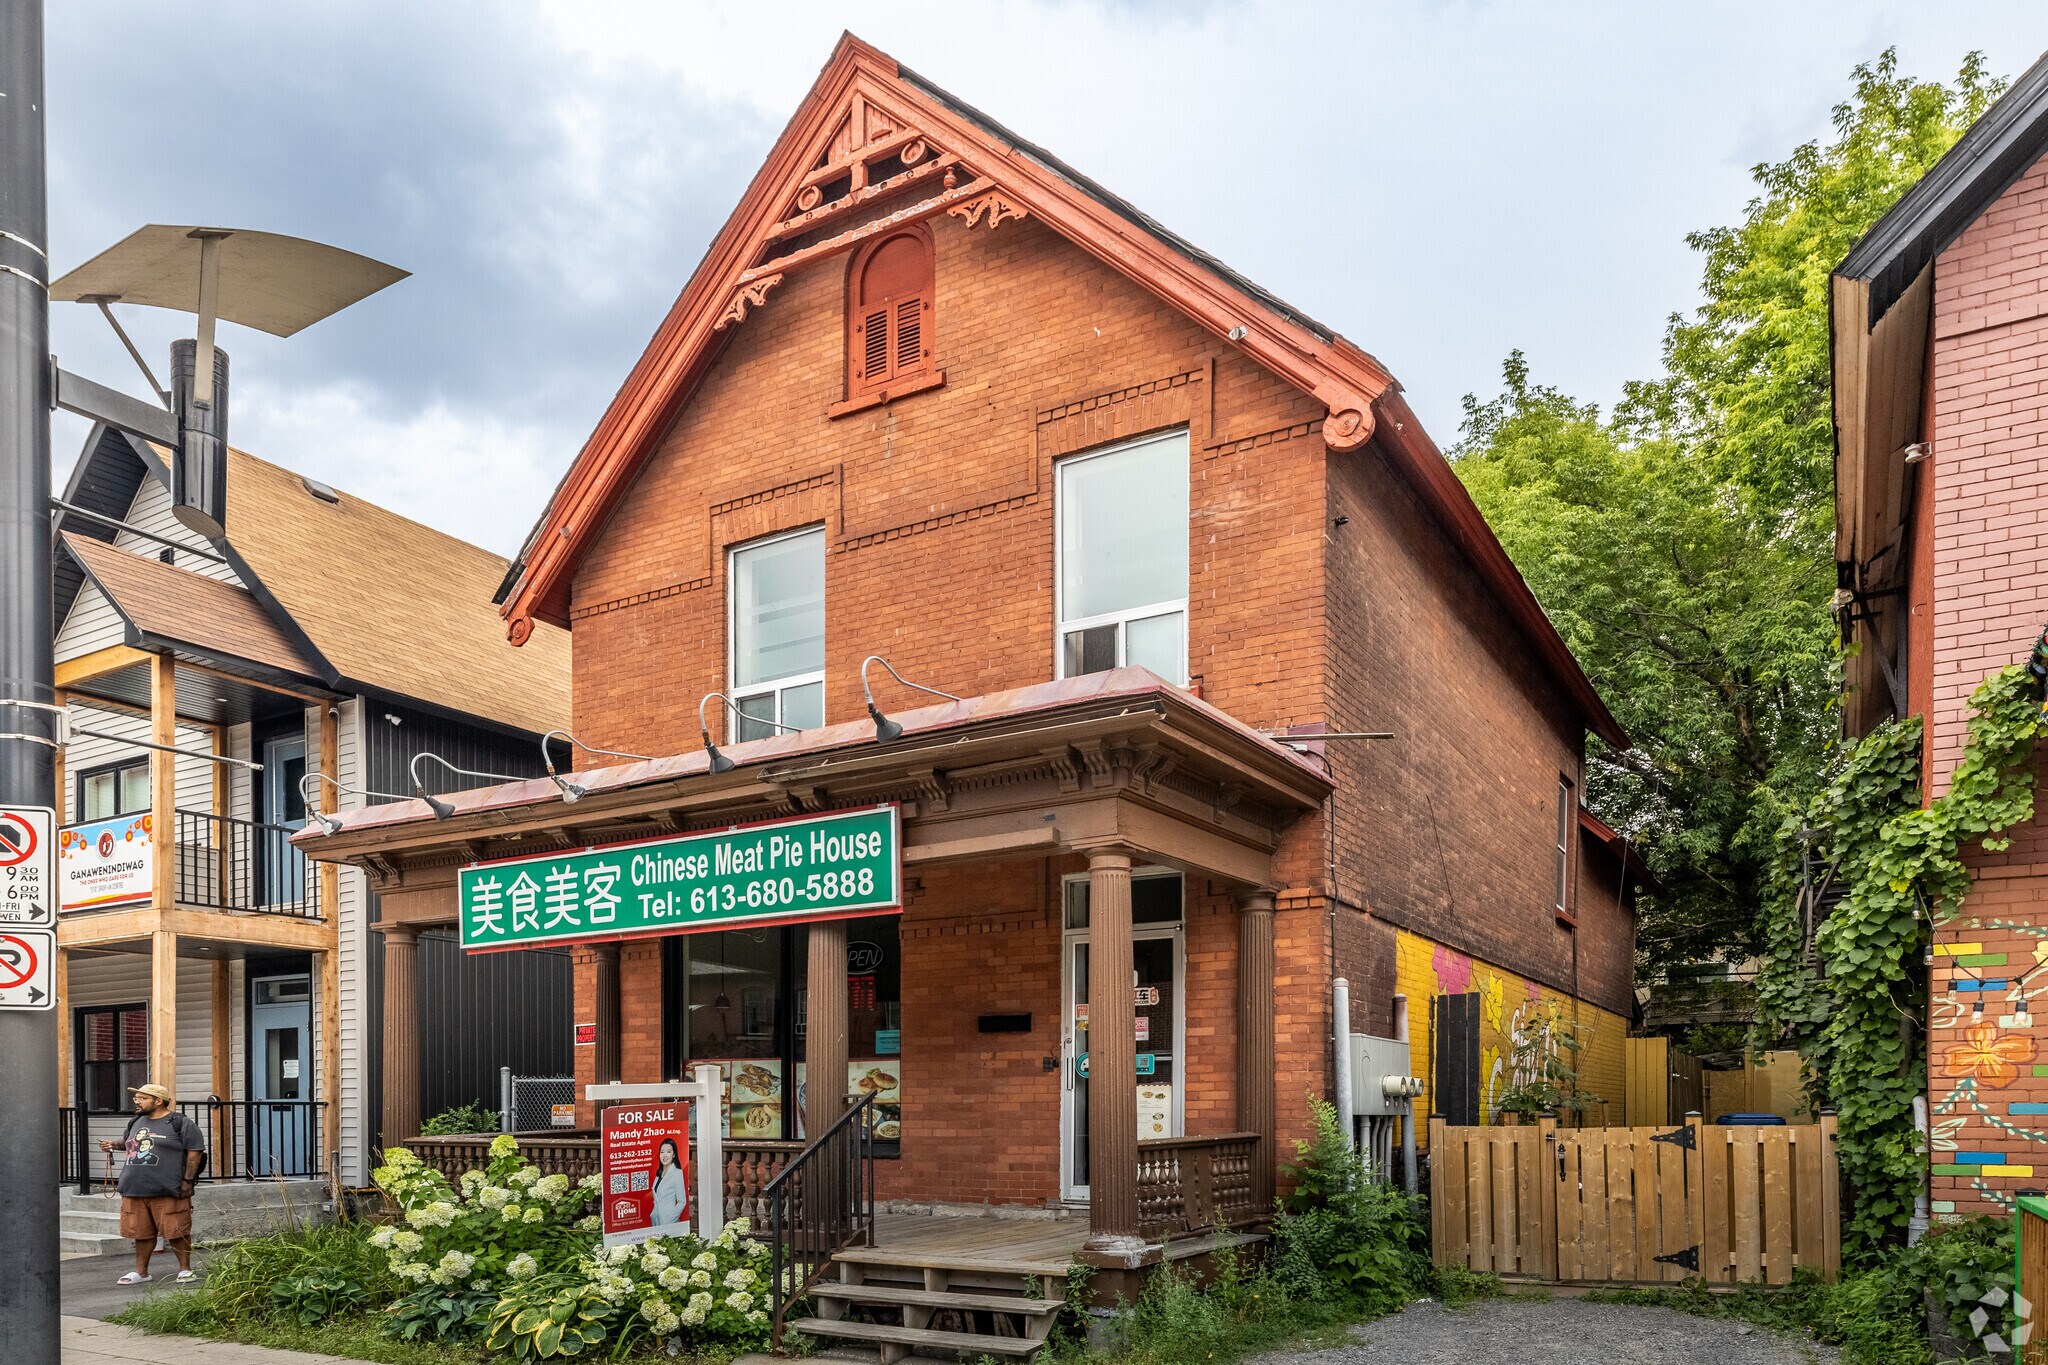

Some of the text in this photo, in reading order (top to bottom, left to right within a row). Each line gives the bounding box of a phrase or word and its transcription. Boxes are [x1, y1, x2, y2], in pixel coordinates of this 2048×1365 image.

[631, 830, 882, 886] Chinese Meat Pie House
[6, 866, 17, 880] 9
[70, 860, 144, 880] GANAWENINDIWAG
[7, 885, 18, 899] 6
[471, 861, 621, 937] 美食美客
[637, 868, 874, 919] Tel: 613-680-5888
[847, 949, 879, 967] PEN
[576, 1034, 596, 1043] PROPERT
[618, 1109, 674, 1124] FOR SALE
[610, 1129, 642, 1140] Mandy
[644, 1127, 665, 1137] Zhao
[610, 1149, 652, 1159] 613-262-1532
[618, 1207, 637, 1218] HOME
